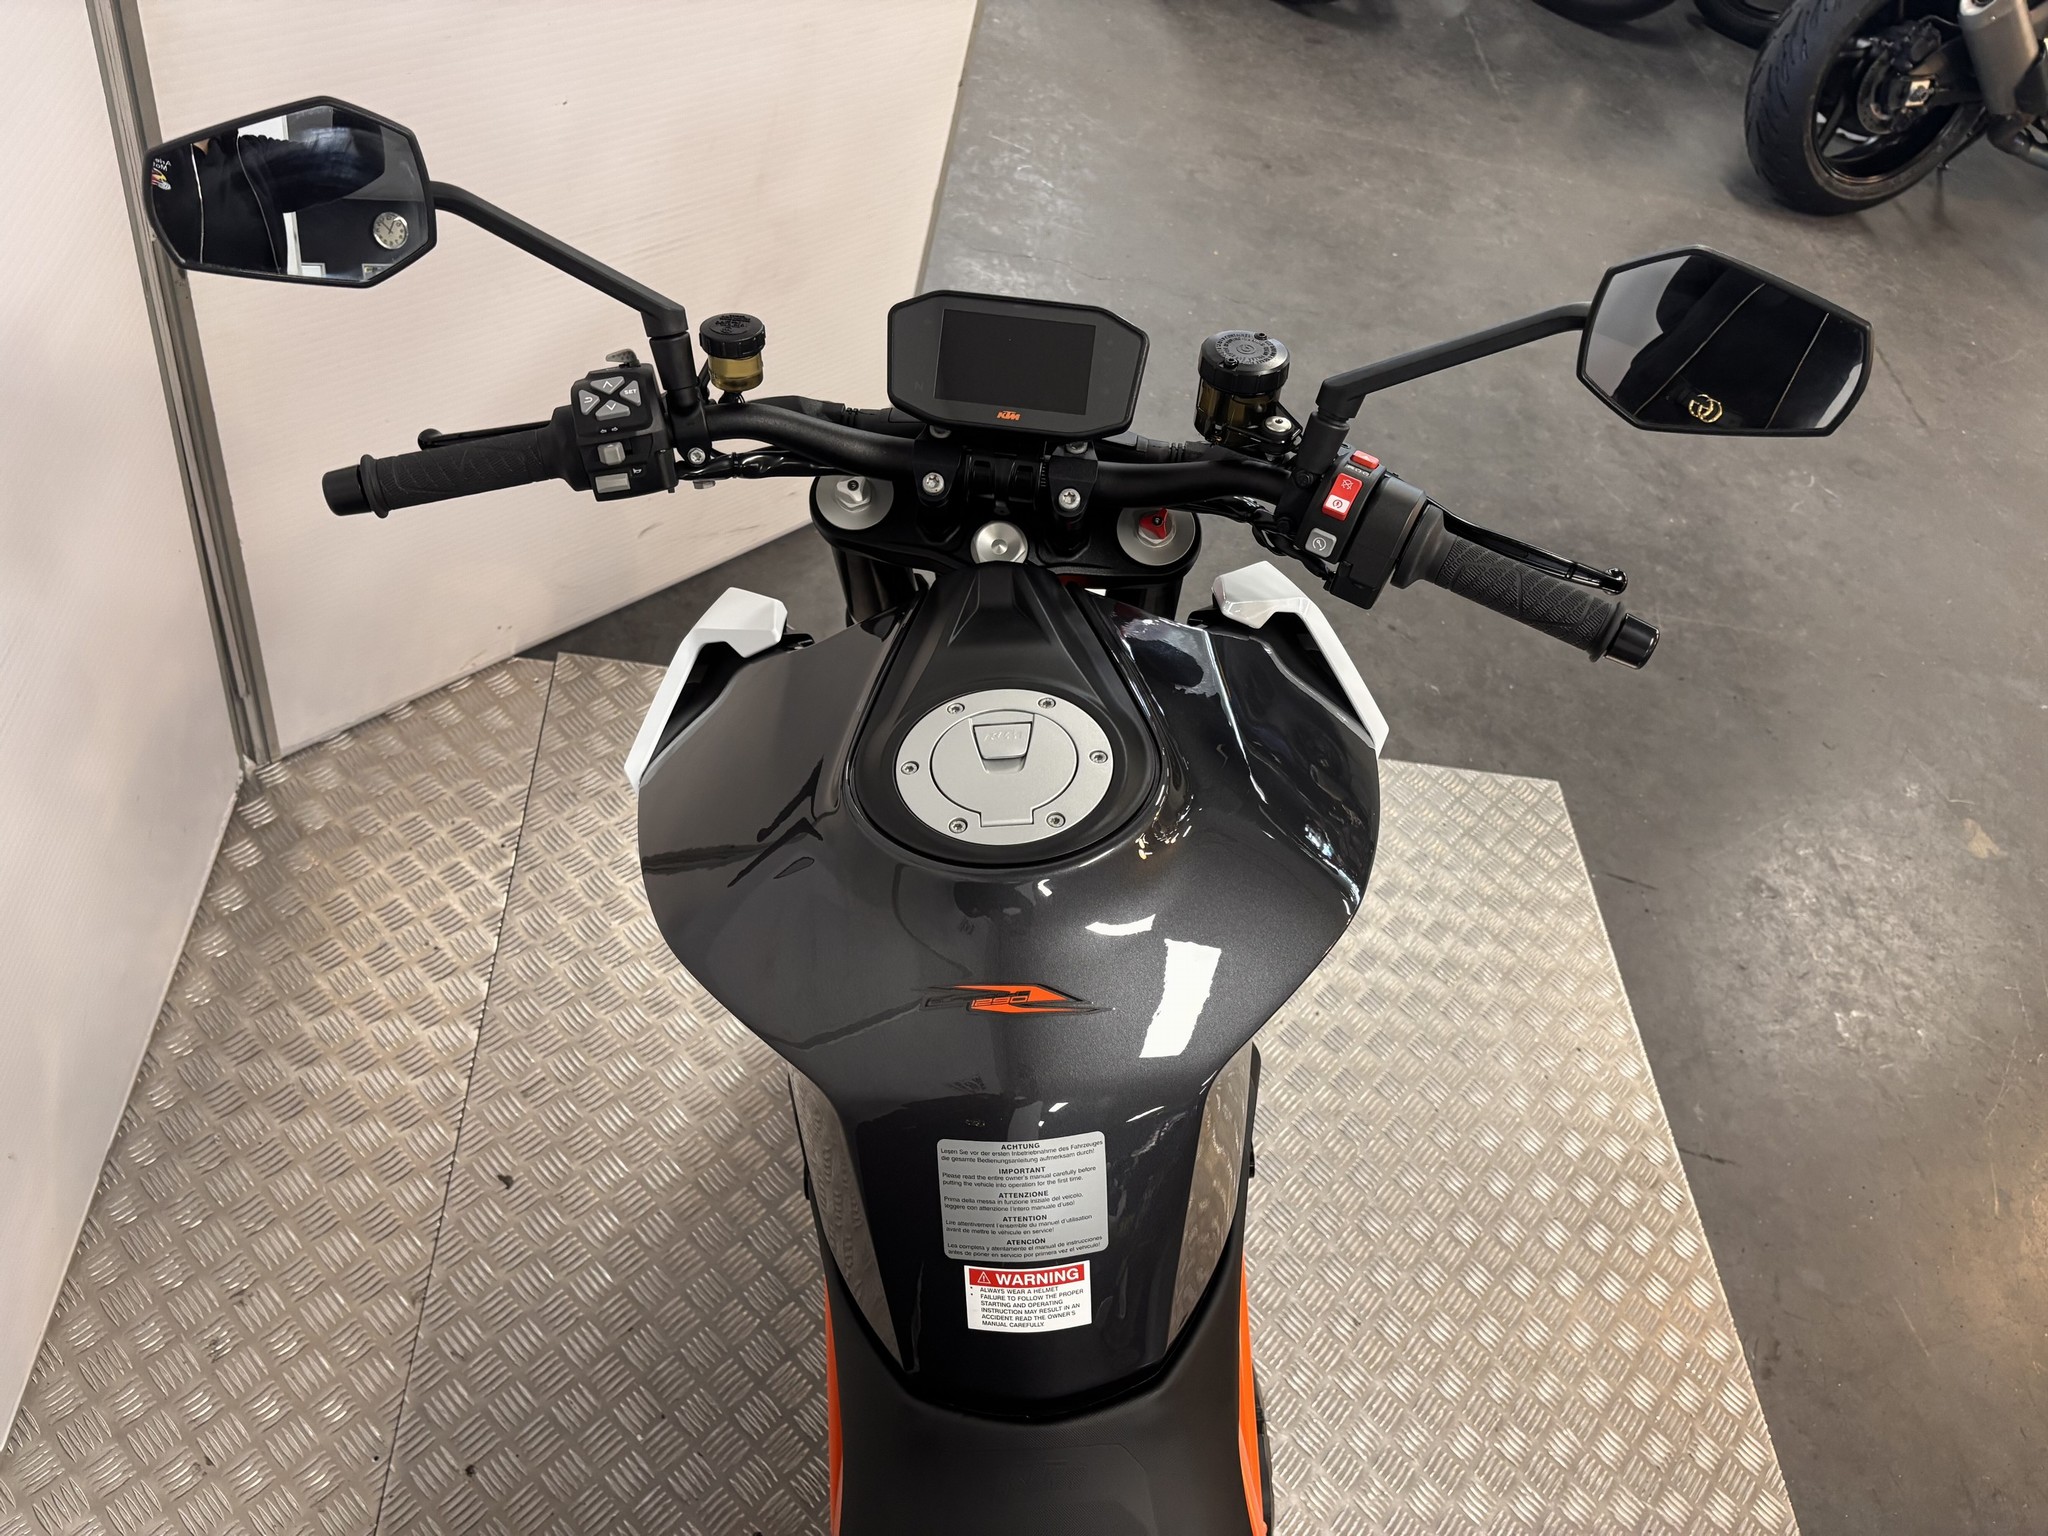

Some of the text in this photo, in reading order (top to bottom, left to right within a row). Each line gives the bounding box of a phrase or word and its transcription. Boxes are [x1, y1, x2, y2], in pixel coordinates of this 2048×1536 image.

[997, 410, 1020, 420] KTM
[1070, 1140, 1103, 1150] Fahrzeuges
[1040, 1152, 1076, 1162] aufmerksam
[998, 1166, 1046, 1174] IMPORTANT
[1053, 1169, 1076, 1178] carefully
[998, 1190, 1048, 1198] ATTENZIONE
[1066, 1236, 1102, 1246] instrucciones
[996, 1268, 1079, 1286] WARNING
[1058, 1288, 1084, 1298] PROPER
[1028, 1299, 1063, 1308] OPERATING
[1038, 1306, 1062, 1314] RESULT
